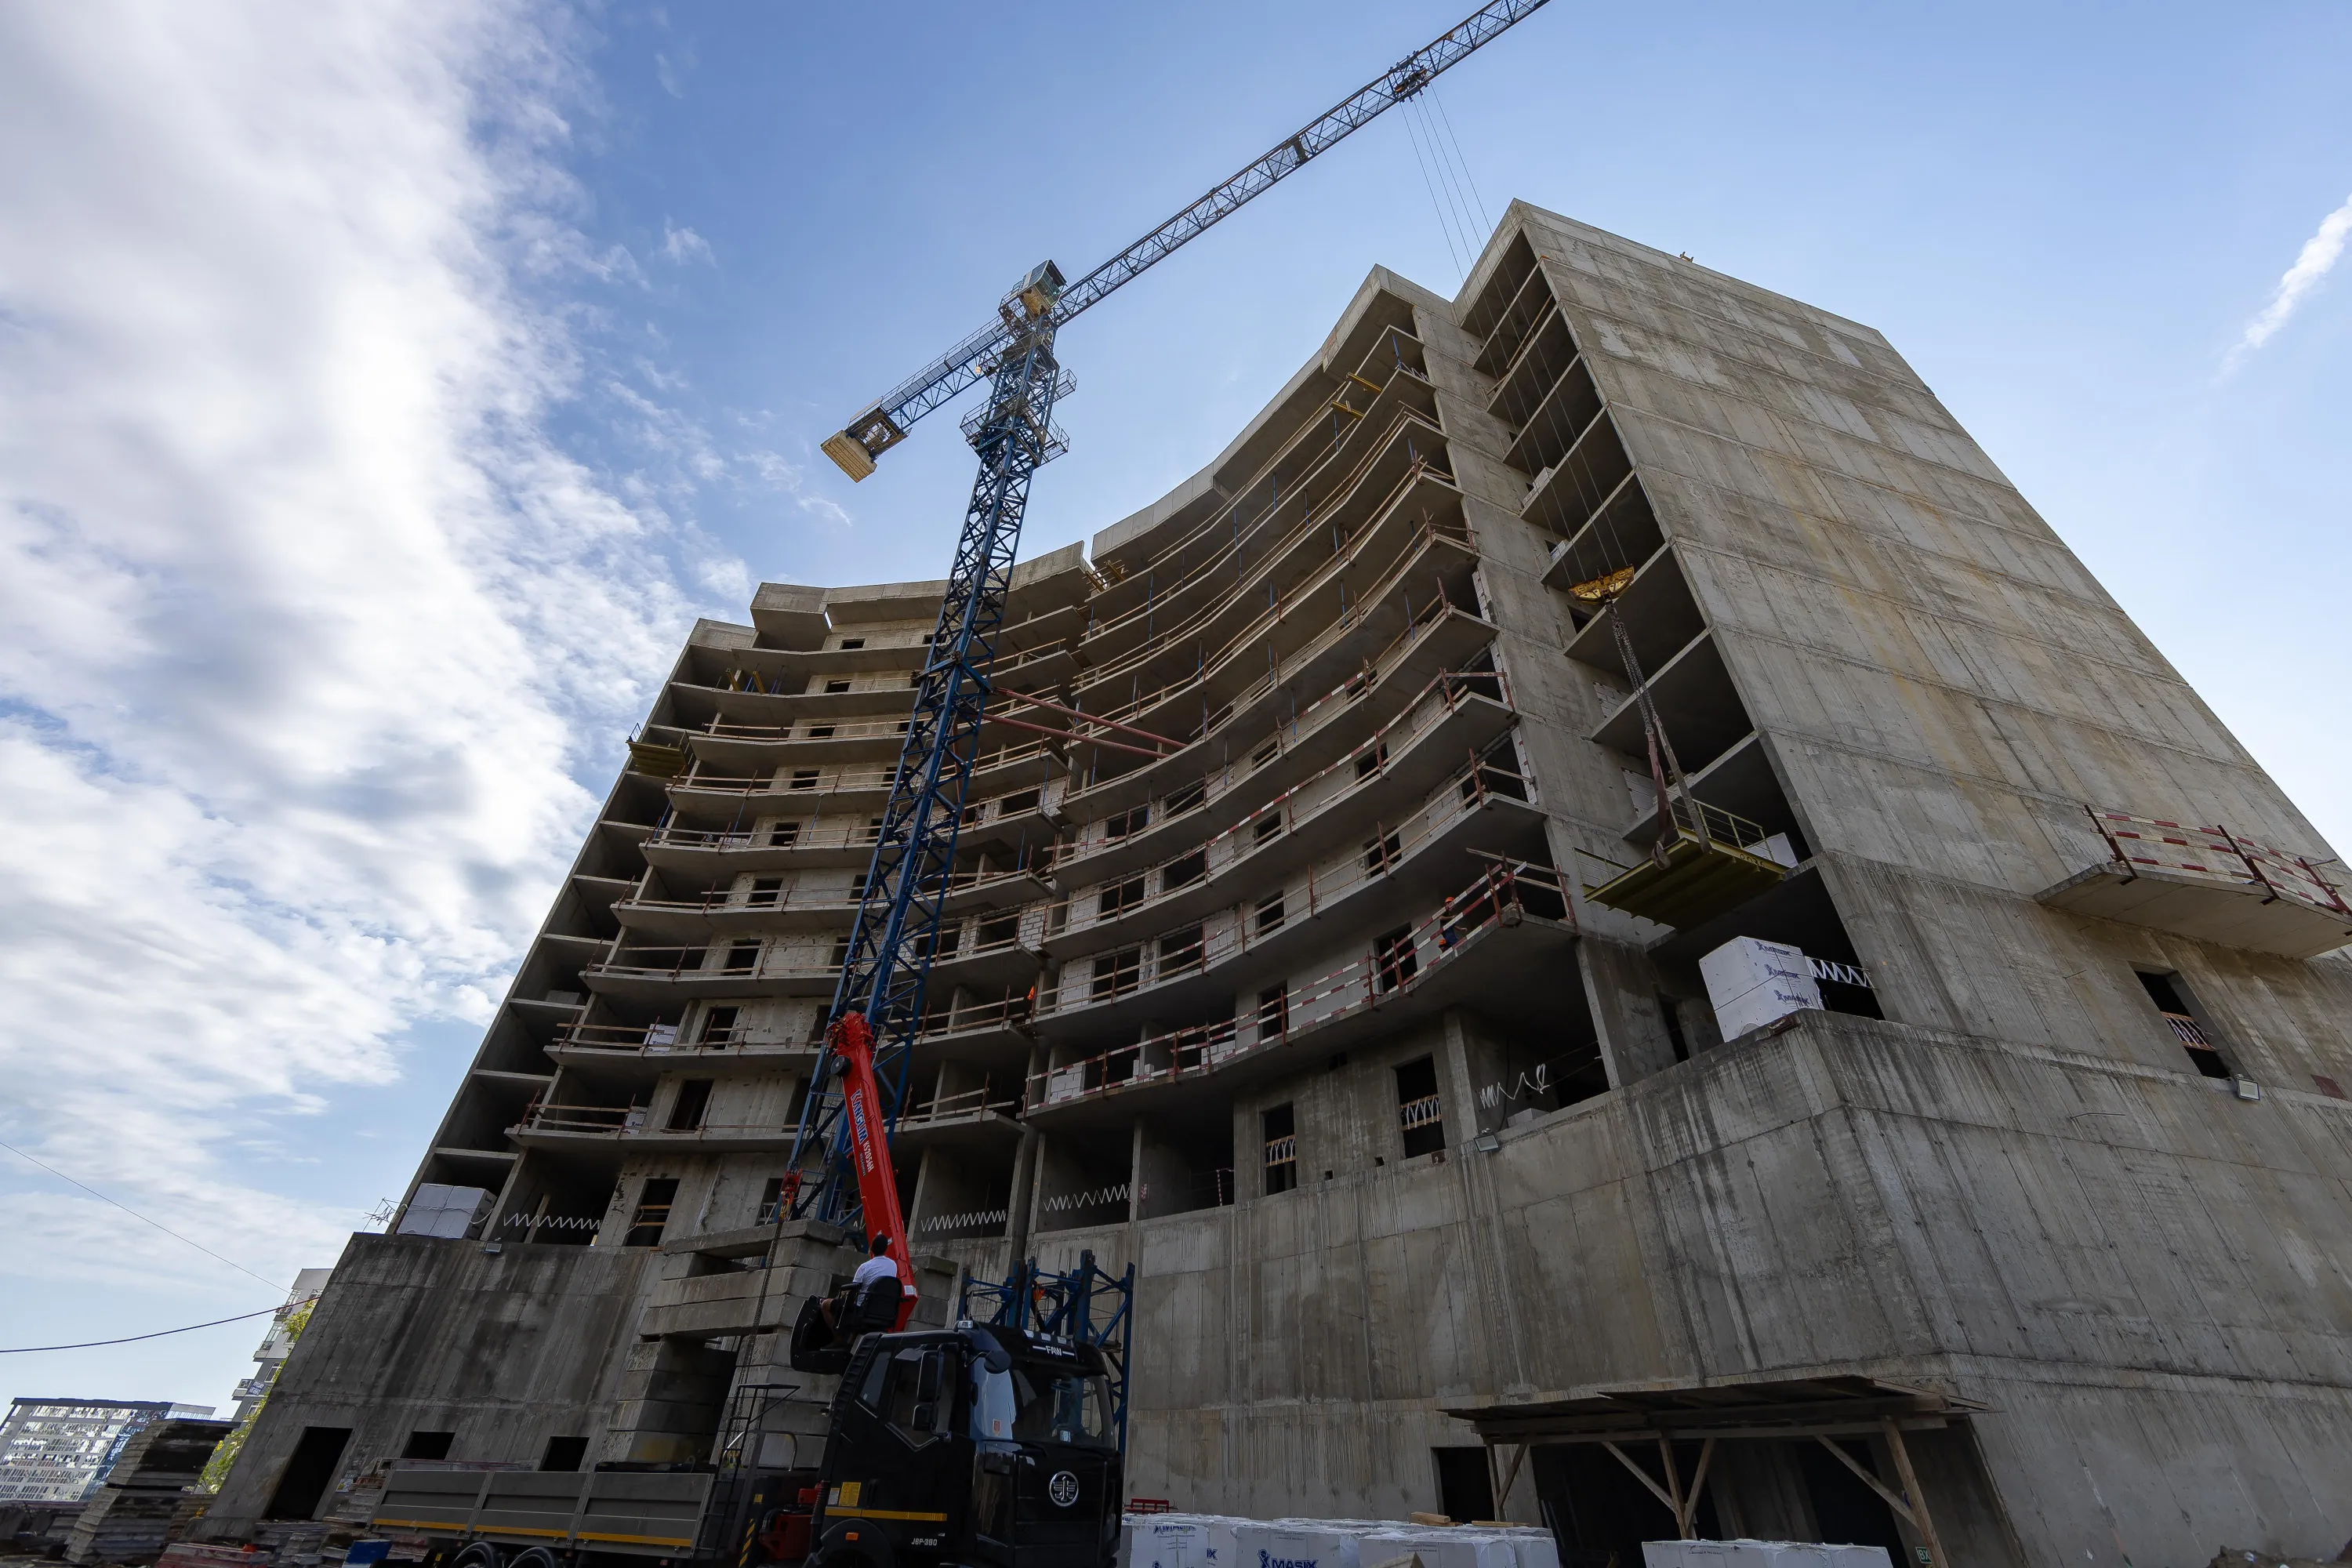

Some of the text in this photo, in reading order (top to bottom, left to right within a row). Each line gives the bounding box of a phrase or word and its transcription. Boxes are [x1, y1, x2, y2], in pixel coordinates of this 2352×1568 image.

[851, 1088, 868, 1145] KANGLIM
[862, 1140, 874, 1173] KS2056H
[1045, 1345, 1062, 1356] FAW
